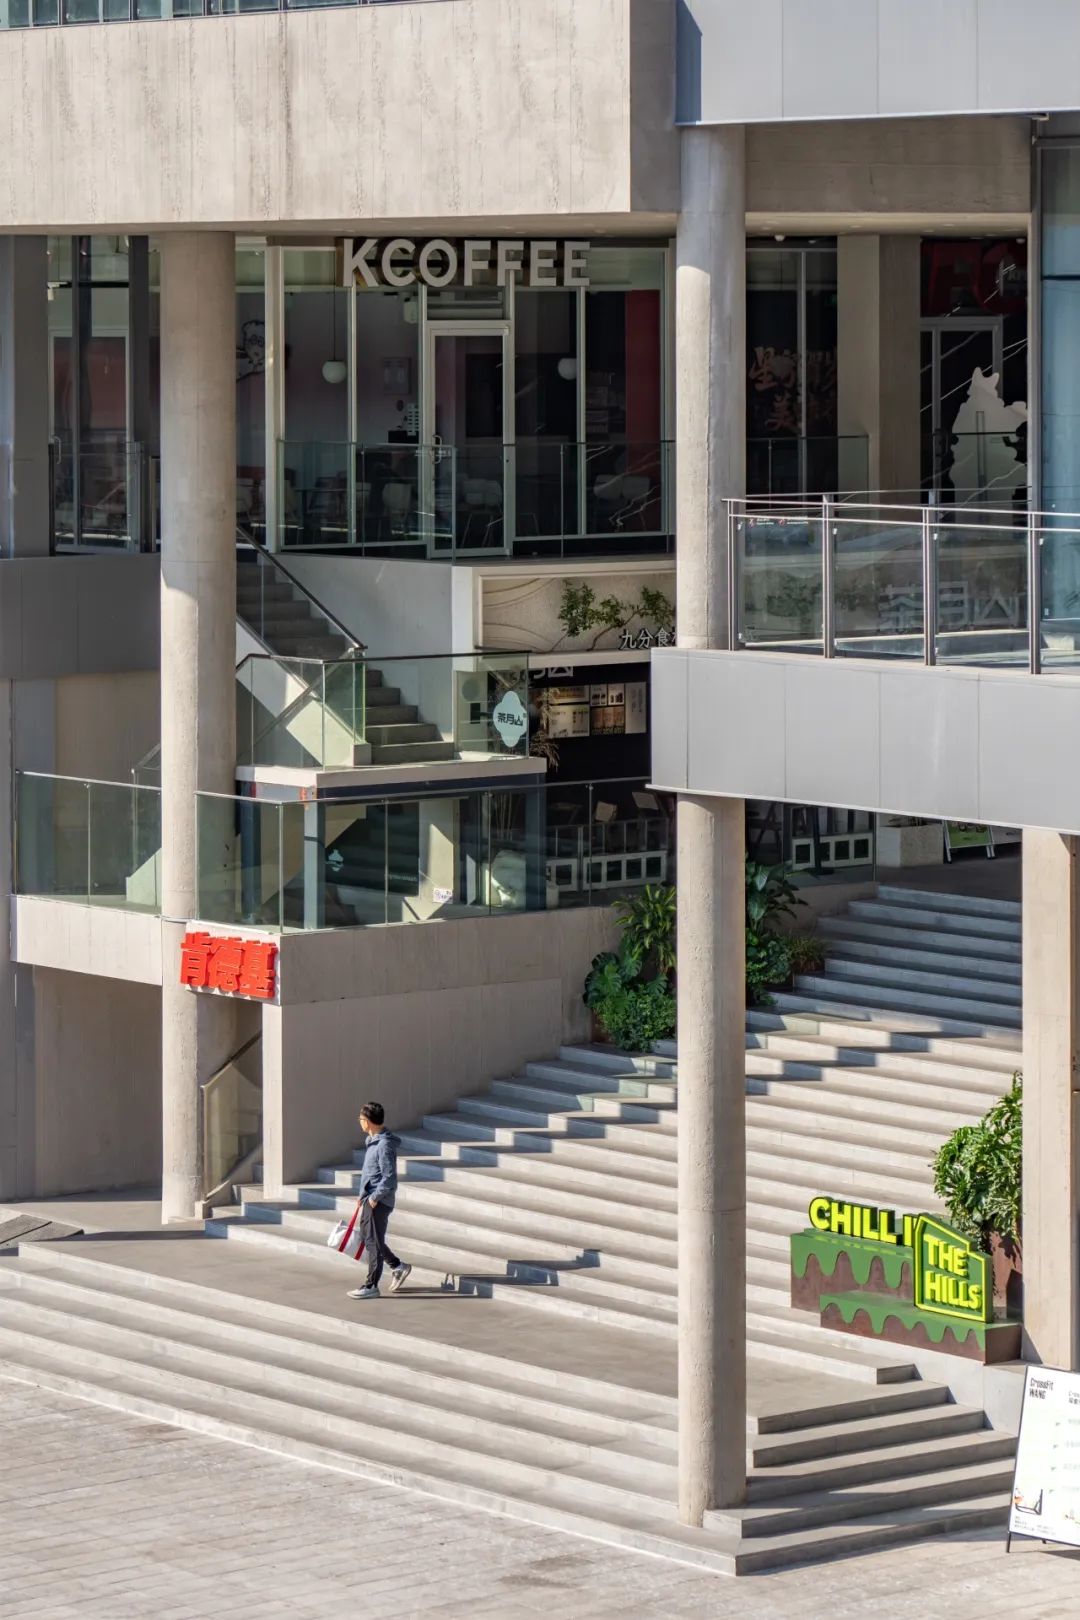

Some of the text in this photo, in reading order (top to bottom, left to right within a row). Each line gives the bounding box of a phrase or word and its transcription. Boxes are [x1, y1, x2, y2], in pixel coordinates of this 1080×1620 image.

[342, 238, 591, 288] KCOFFEE
[619, 626, 677, 650] 九分食
[497, 712, 524, 726] 茶月山
[180, 931, 276, 999] 肯德基
[808, 1197, 918, 1247] CHILL I
[923, 1233, 969, 1277] THE
[925, 1270, 983, 1311] HILLS
